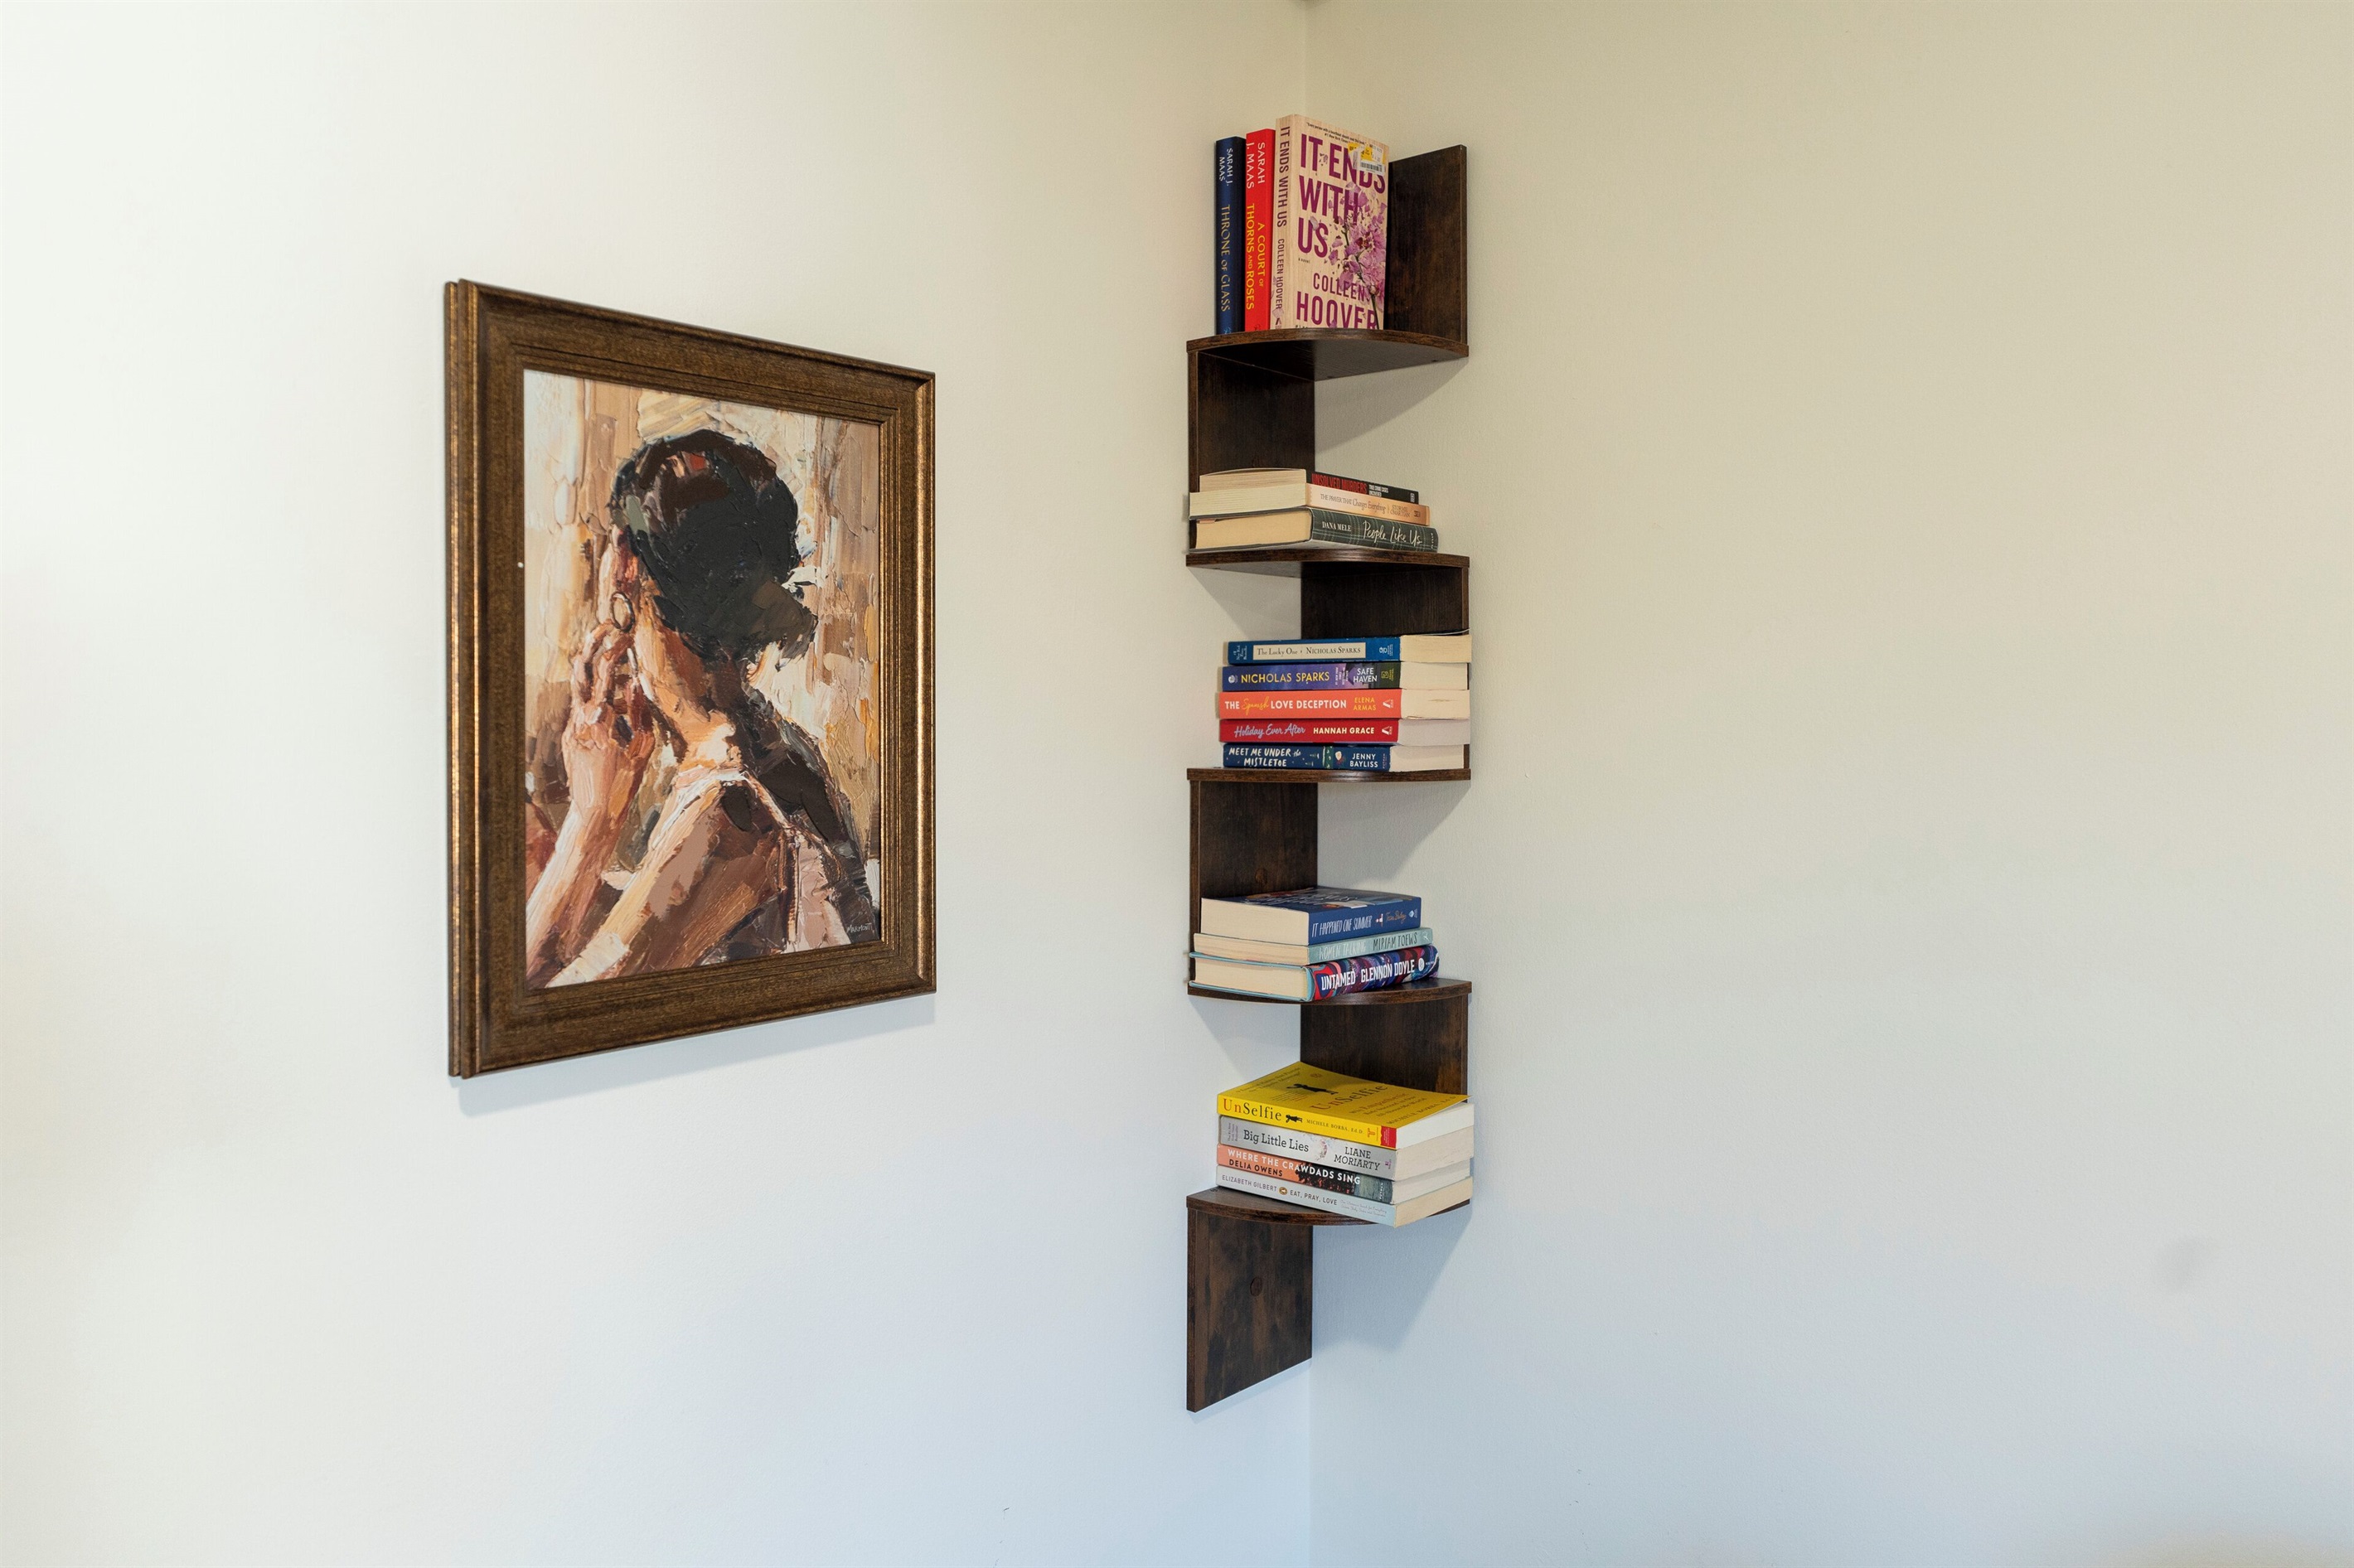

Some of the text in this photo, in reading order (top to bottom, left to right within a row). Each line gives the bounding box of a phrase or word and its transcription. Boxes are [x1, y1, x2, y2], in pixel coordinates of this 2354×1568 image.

[1301, 133, 1323, 172] IT
[1247, 153, 1255, 189] MAAS
[1276, 126, 1291, 228] IT ENDS WITH US
[1299, 174, 1359, 225] WITH
[1246, 203, 1255, 253] THORNS
[1257, 222, 1265, 231] A
[1297, 217, 1329, 259] US
[1220, 204, 1231, 312] THRONE OF GLASS
[1276, 239, 1285, 274] COLLEEN
[1246, 270, 1255, 310] ROSES
[1313, 273, 1370, 302] COLLEEN
[1296, 291, 1377, 329] HOOVER
[1311, 473, 1368, 494] UNSOLVED MURDERS
[1329, 495, 1343, 503] PRAYER
[1322, 520, 1352, 532] DANA MELE
[1363, 520, 1387, 544] People
[1390, 526, 1407, 544] Like
[1410, 530, 1422, 547] Us
[1268, 647, 1285, 656] Lucky
[1241, 671, 1330, 684] NICHOLAS SPARKS
[1357, 667, 1374, 675] SAFE
[1224, 695, 1347, 716] THE Spanish LOVE DECEPTION
[1234, 724, 1264, 739] Holiday
[1266, 724, 1283, 736] Ever
[1284, 723, 1305, 736] After
[1228, 748, 1249, 756] MEET
[1264, 748, 1291, 757] UNDER
[1293, 749, 1301, 757] the
[1244, 757, 1286, 767] MISTLETOE
[1311, 915, 1373, 937] IT HAPPENED ONE SUMMER
[1319, 932, 1417, 960] WOMEN TALKING MIRIAM TOEWS
[1321, 959, 1415, 991] UNTAMED GLENNON DOYLE
[1310, 1086, 1388, 1110] UnSelfie
[1223, 1098, 1282, 1121] UnSelfie
[1306, 1119, 1329, 1127] MICHELE
[1330, 1124, 1350, 1132] BORBA,
[1243, 1130, 1309, 1152] Big Little Lies
[1344, 1146, 1371, 1159] LIANE
[1228, 1149, 1361, 1185] WHERE THE CRAWDADS SING
[1229, 1159, 1283, 1177] DELIA OWENS
[1334, 1154, 1381, 1171] MORIARTY
[1222, 1174, 1252, 1186] ELIZABETH
[1253, 1182, 1277, 1192] GILBERT
[1304, 1193, 1321, 1203] PRAY,
[1322, 1198, 1338, 1206] LOVE
